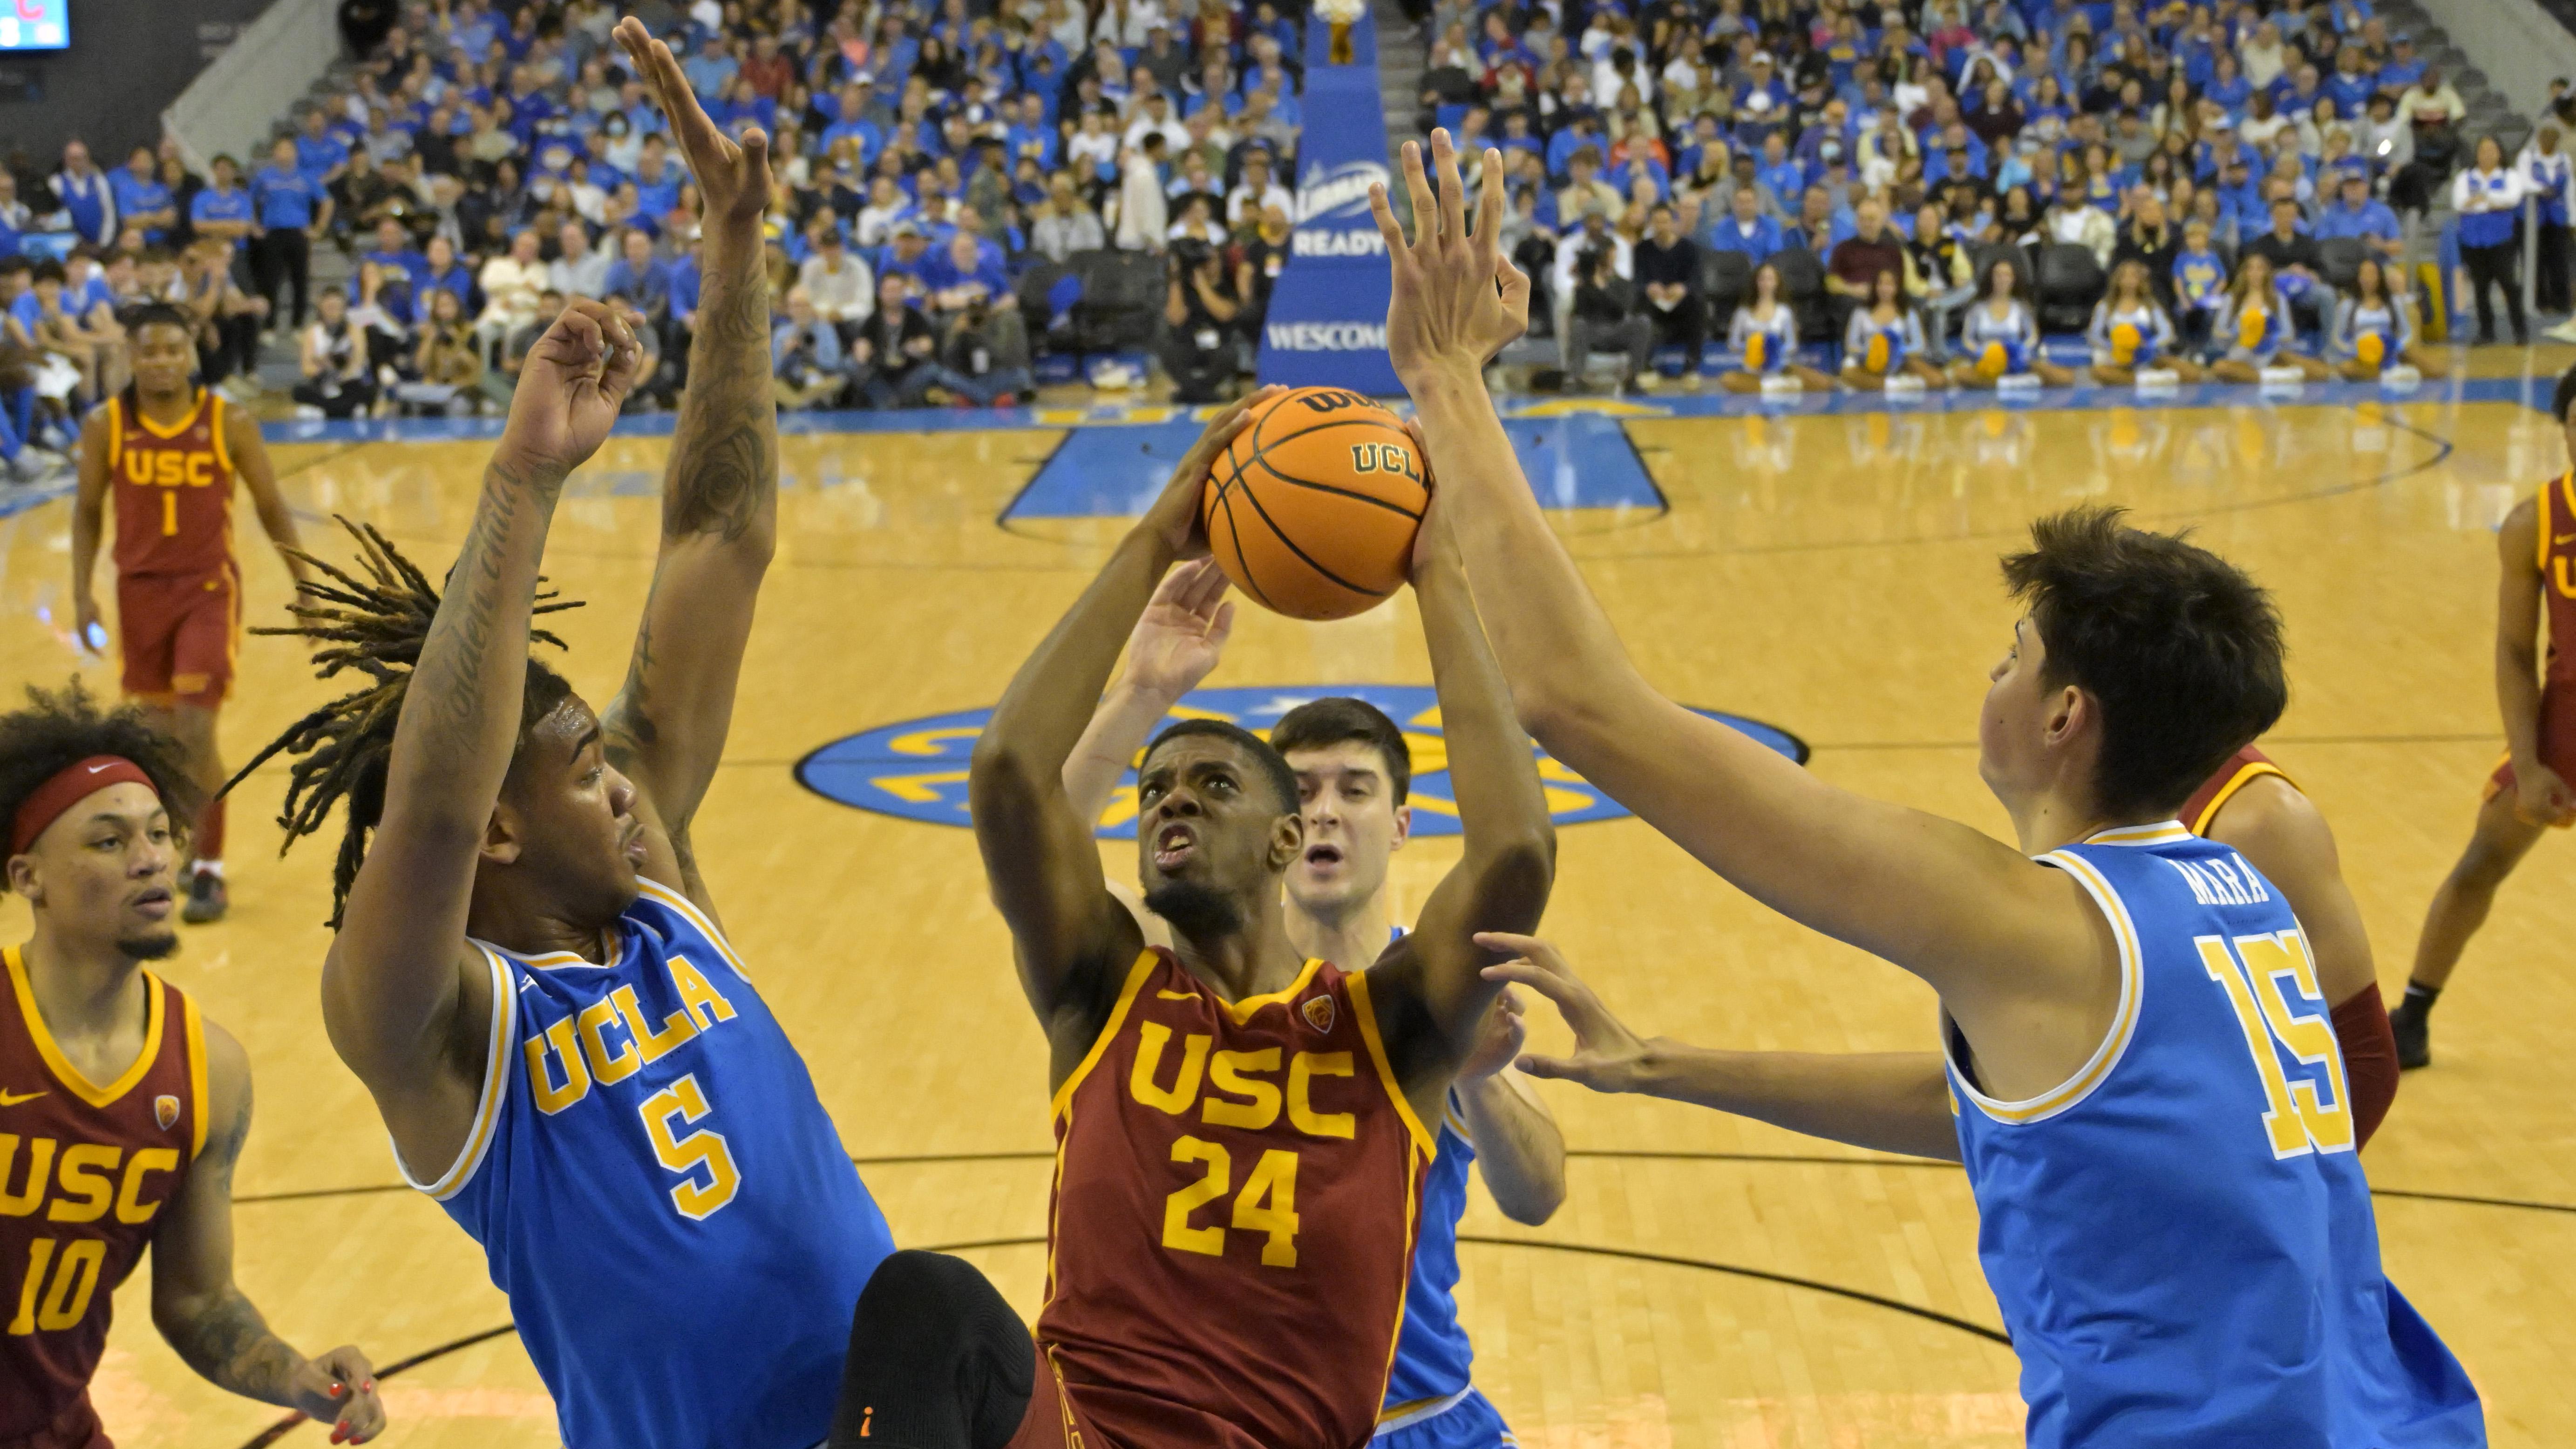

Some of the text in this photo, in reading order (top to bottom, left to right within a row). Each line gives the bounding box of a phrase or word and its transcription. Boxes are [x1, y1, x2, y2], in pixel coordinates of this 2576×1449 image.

[1292, 230, 1387, 256] READY
[1266, 322, 1387, 350] WESCOM
[125, 449, 214, 487] USC
[162, 490, 178, 536] 1
[2166, 852, 2270, 905] MARA
[523, 954, 738, 1116] UCLA
[1130, 1020, 1355, 1140] USC
[2194, 929, 2355, 1161] 15
[0, 1133, 180, 1225] USC
[638, 1072, 741, 1221] 5
[1162, 1135, 1299, 1268] 24
[8, 1237, 107, 1336] 10
